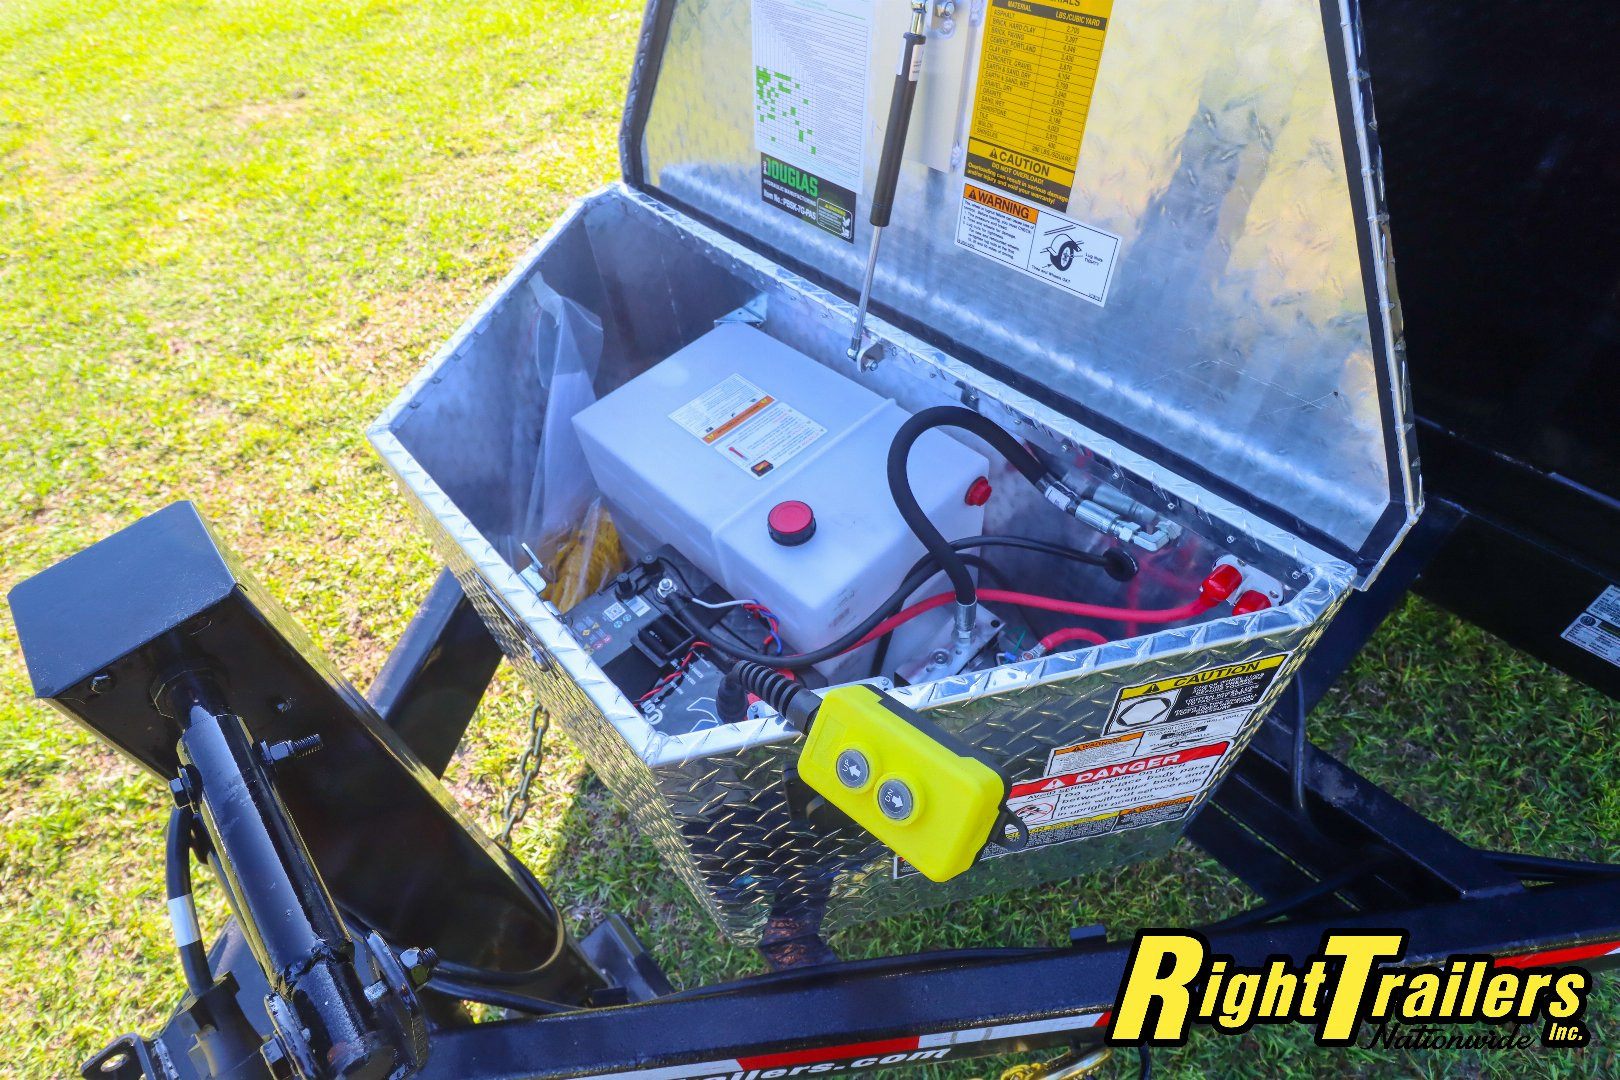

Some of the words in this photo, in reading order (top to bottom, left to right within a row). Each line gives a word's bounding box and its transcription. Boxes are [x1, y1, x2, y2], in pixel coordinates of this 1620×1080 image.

[994, 9, 1014, 18] ASPHALT
[1086, 17, 1100, 26] YARD
[1000, 152, 1050, 176] CAUTION
[1001, 165, 1012, 174] NOT
[968, 161, 997, 177] Overloading
[1007, 176, 1020, 185] result
[1028, 184, 1046, 194] serious
[1048, 191, 1068, 202] damage
[984, 174, 996, 183] injury
[978, 191, 1029, 219] WARNING
[1174, 662, 1260, 686] CAUTION
[842, 759, 849, 771] UP
[1076, 754, 1181, 783] DANGER
[1110, 778, 1141, 788] place
[1147, 771, 1174, 780] body
[1180, 765, 1210, 774] parts
[1060, 801, 1090, 810] frame
[1094, 792, 1134, 803] without
[1138, 784, 1175, 794] service
[1178, 778, 1201, 787] pole
[1062, 791, 1110, 804] between
[1116, 783, 1150, 792] trailer
[1153, 776, 1181, 785] body
[1184, 770, 1206, 778] and
[1070, 804, 1108, 814] upright
[1110, 793, 1155, 807] position.
